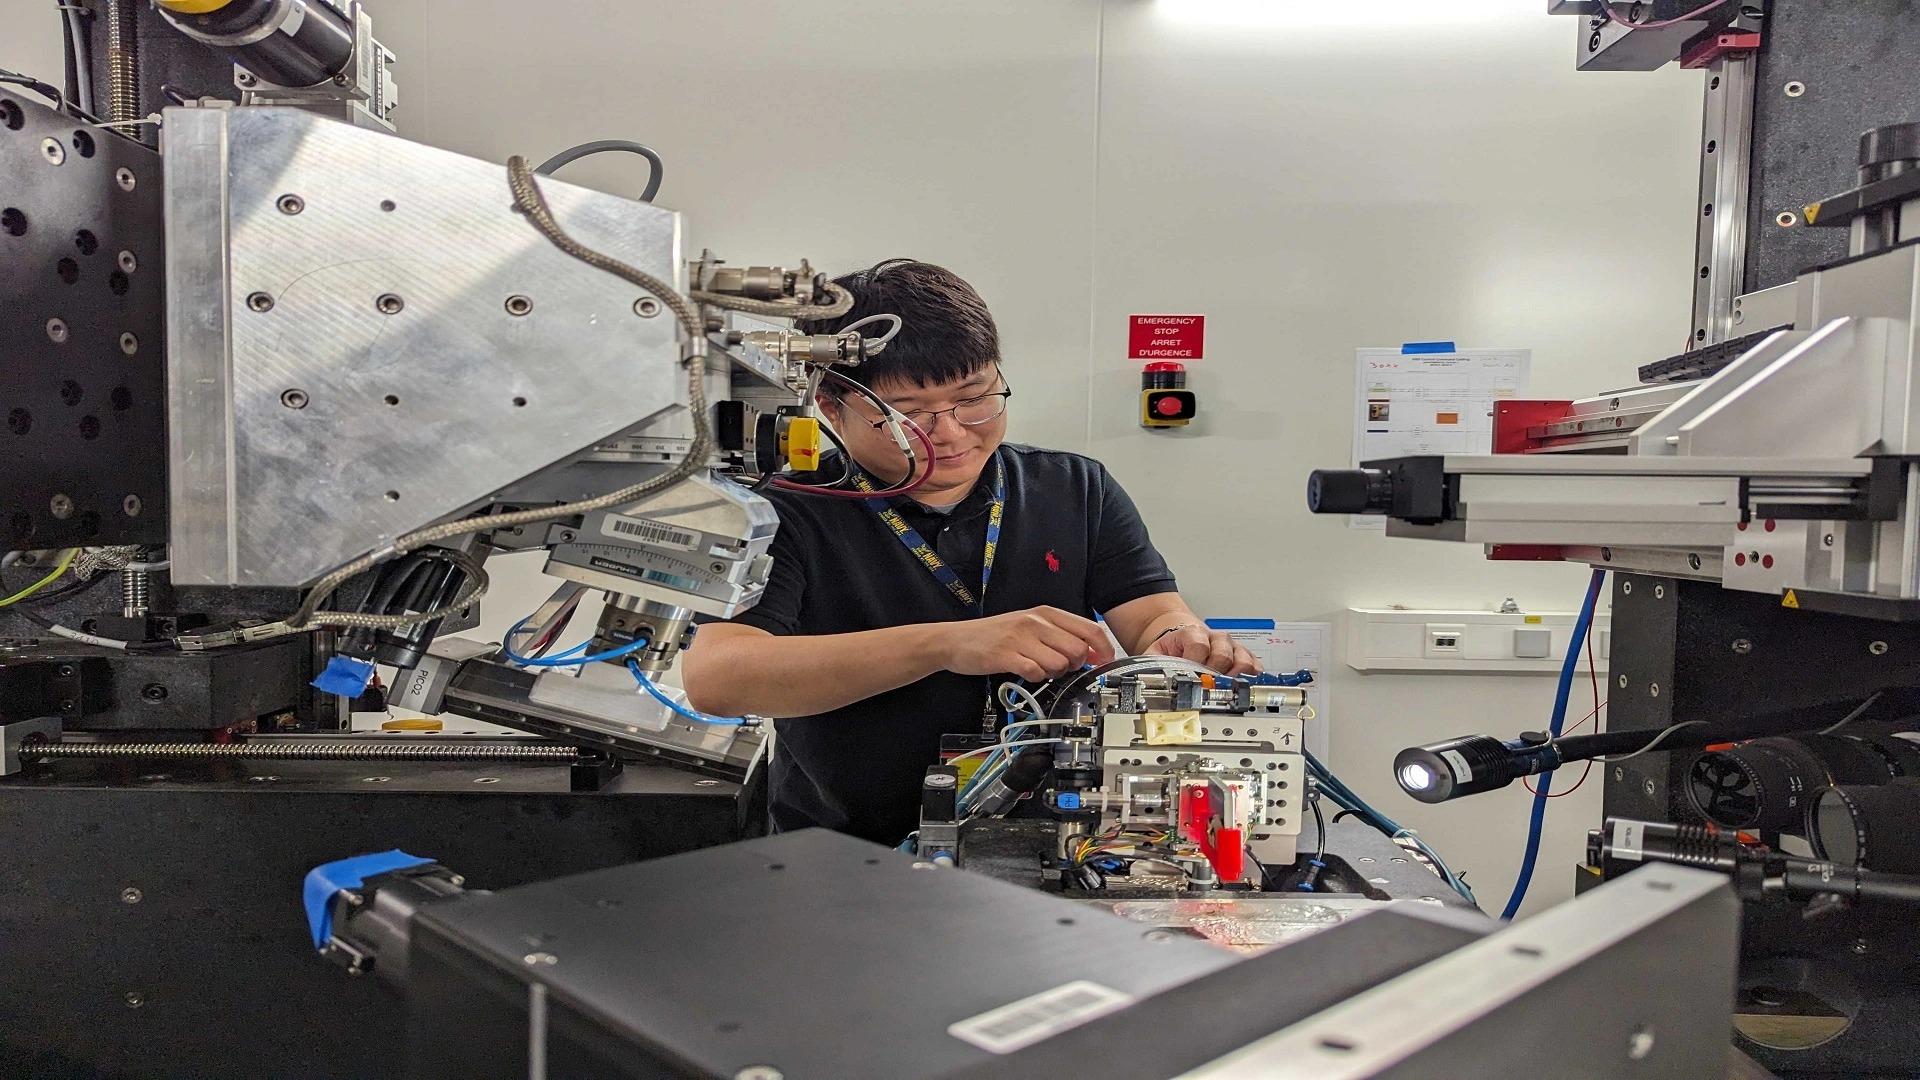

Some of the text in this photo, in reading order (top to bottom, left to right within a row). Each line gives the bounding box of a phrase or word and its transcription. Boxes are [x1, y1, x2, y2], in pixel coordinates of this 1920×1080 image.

[889, 516, 910, 533] NAVY
[923, 552, 944, 568] NAVY
[411, 670, 428, 696] PICO2
